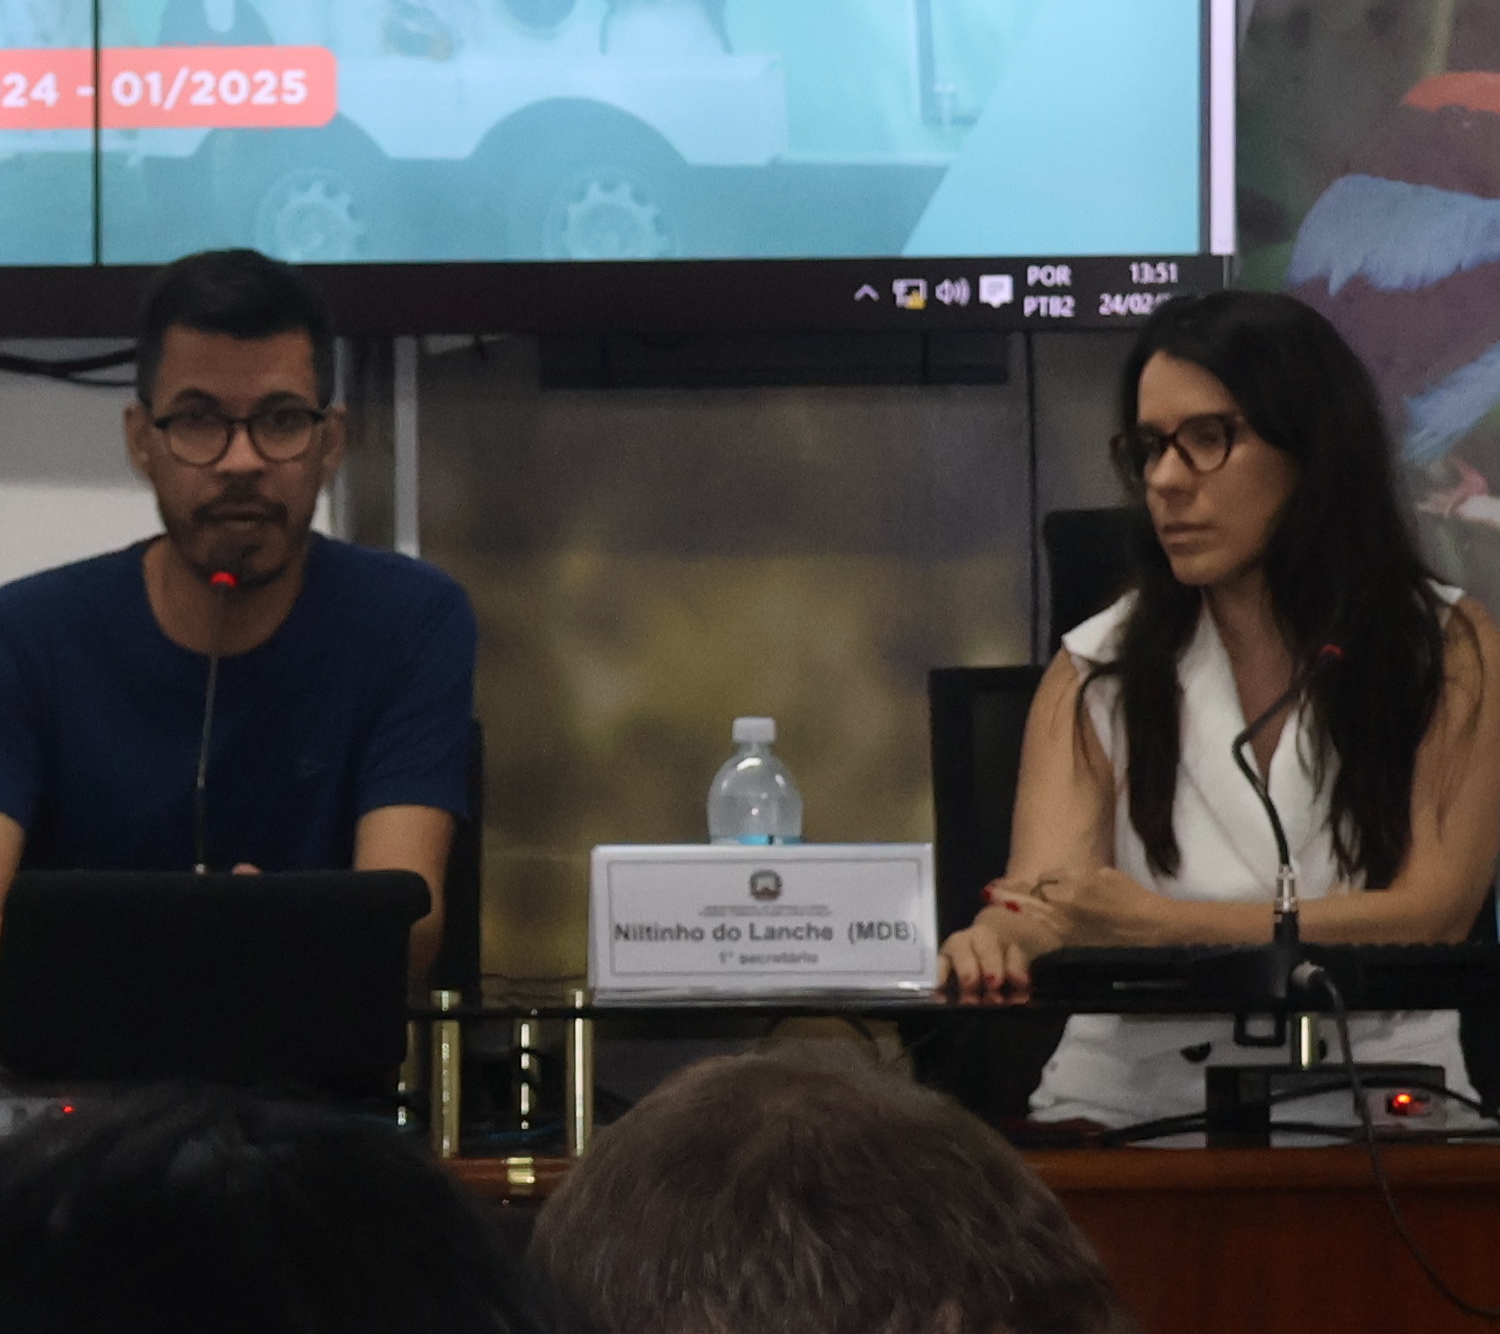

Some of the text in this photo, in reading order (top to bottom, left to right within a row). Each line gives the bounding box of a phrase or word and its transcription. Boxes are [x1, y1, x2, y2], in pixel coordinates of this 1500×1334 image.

[111, 68, 308, 111] 01/2025
[1026, 264, 1072, 287] POR
[613, 921, 918, 944] Niltinho do Lanche (MDB)
